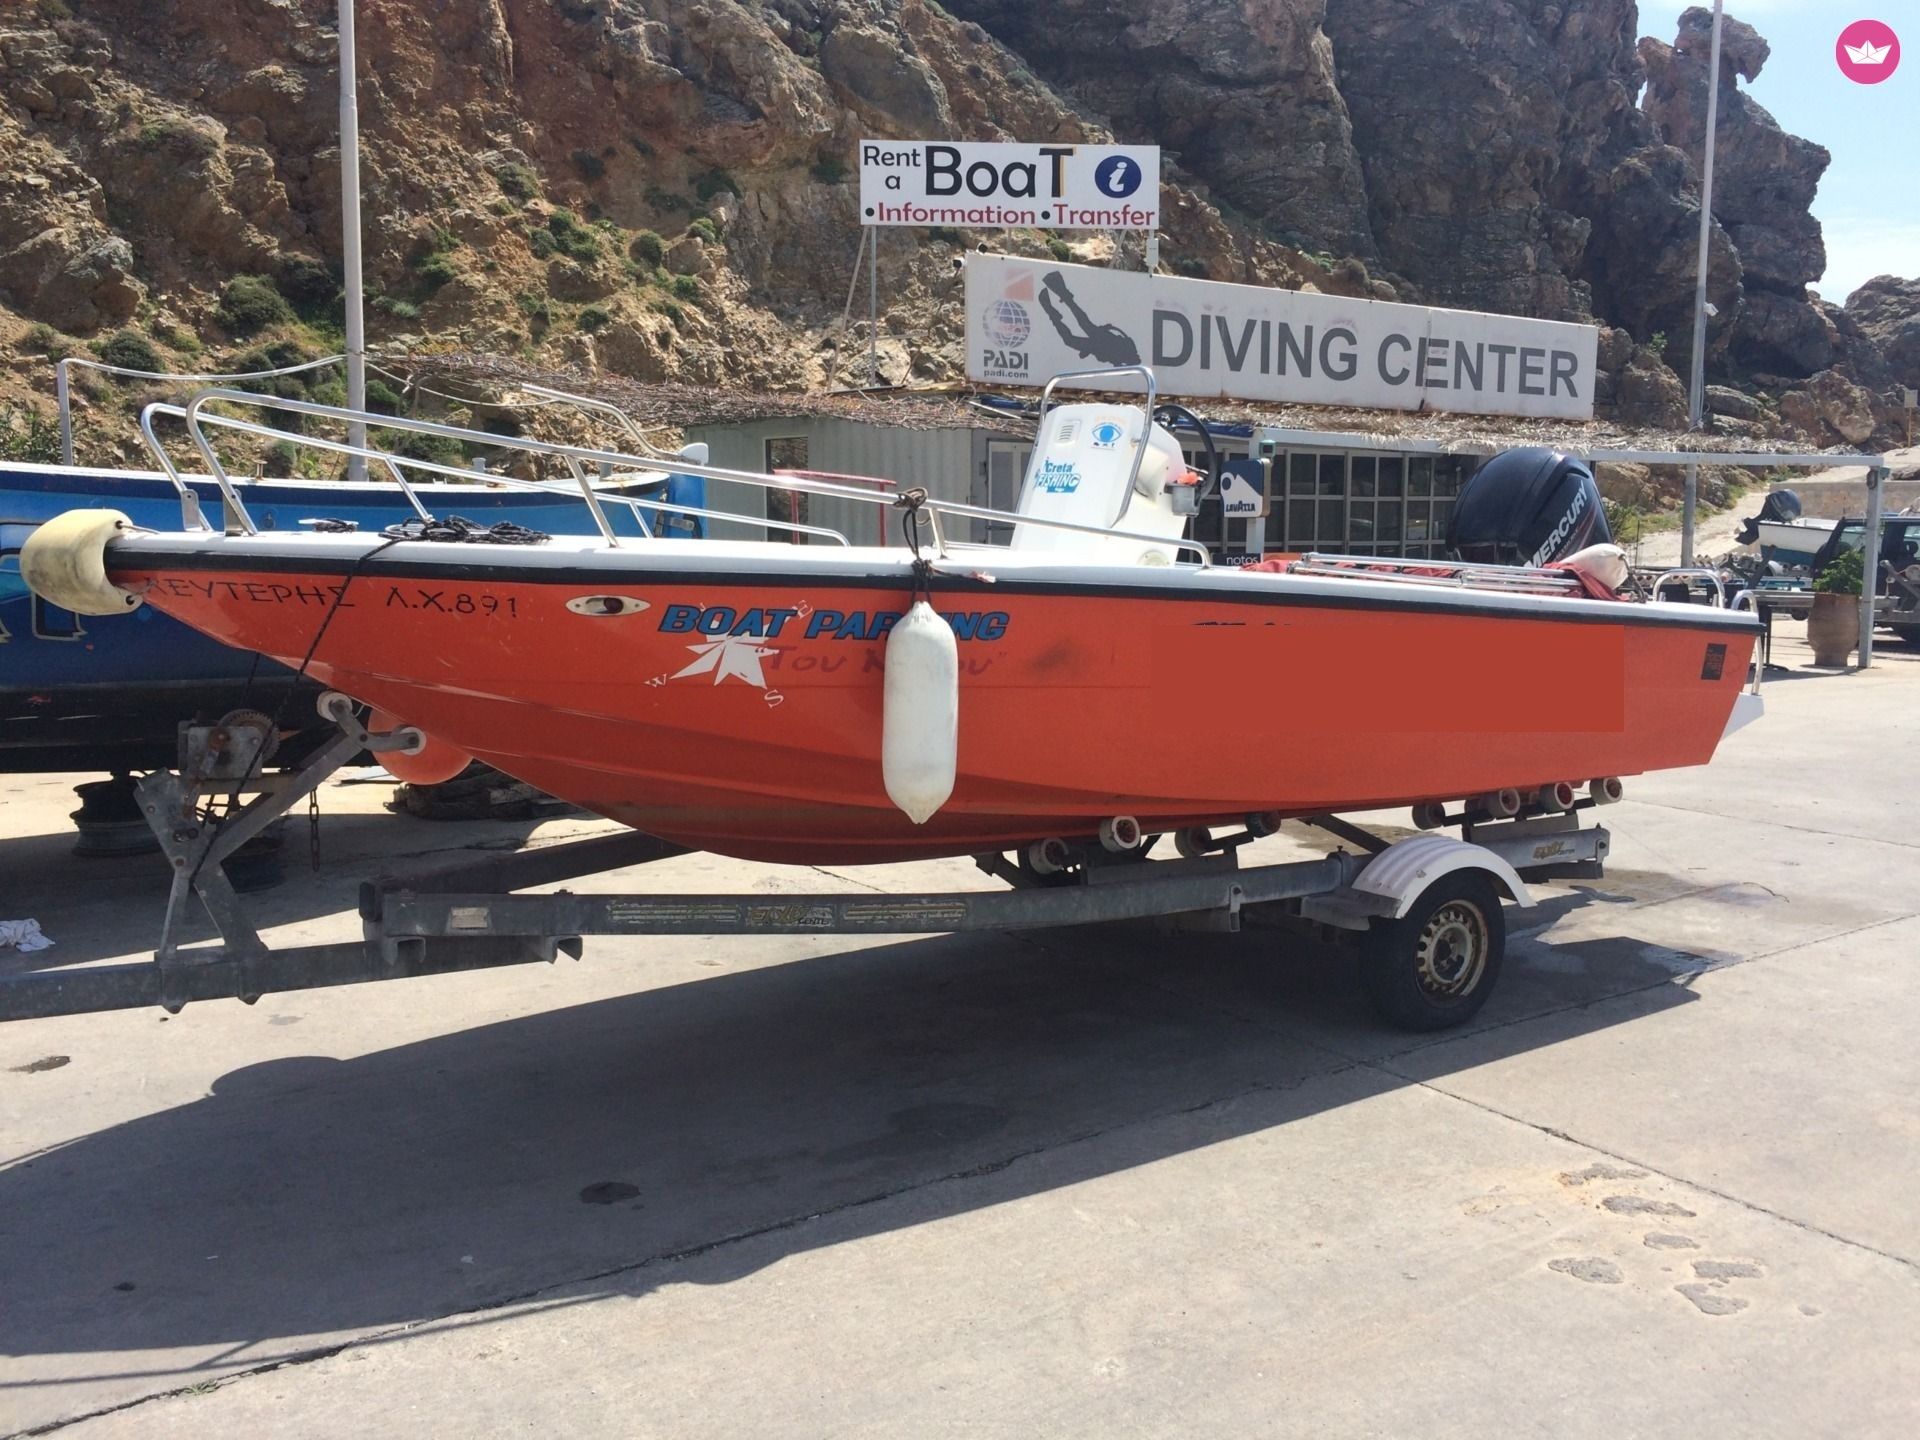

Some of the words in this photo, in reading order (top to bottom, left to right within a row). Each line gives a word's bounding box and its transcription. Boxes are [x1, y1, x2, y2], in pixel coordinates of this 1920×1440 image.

[864, 145, 921, 167] Rent
[885, 175, 901, 190] a
[925, 145, 1074, 198] BoaT
[983, 349, 1029, 370] PADI
[1152, 309, 1359, 381] DIVING
[1376, 332, 1579, 399] CENTER
[983, 369, 1029, 379] padi.com
[1524, 480, 1588, 568] MERCURY
[1226, 555, 1259, 566] notos
[657, 604, 798, 638] BOAT
